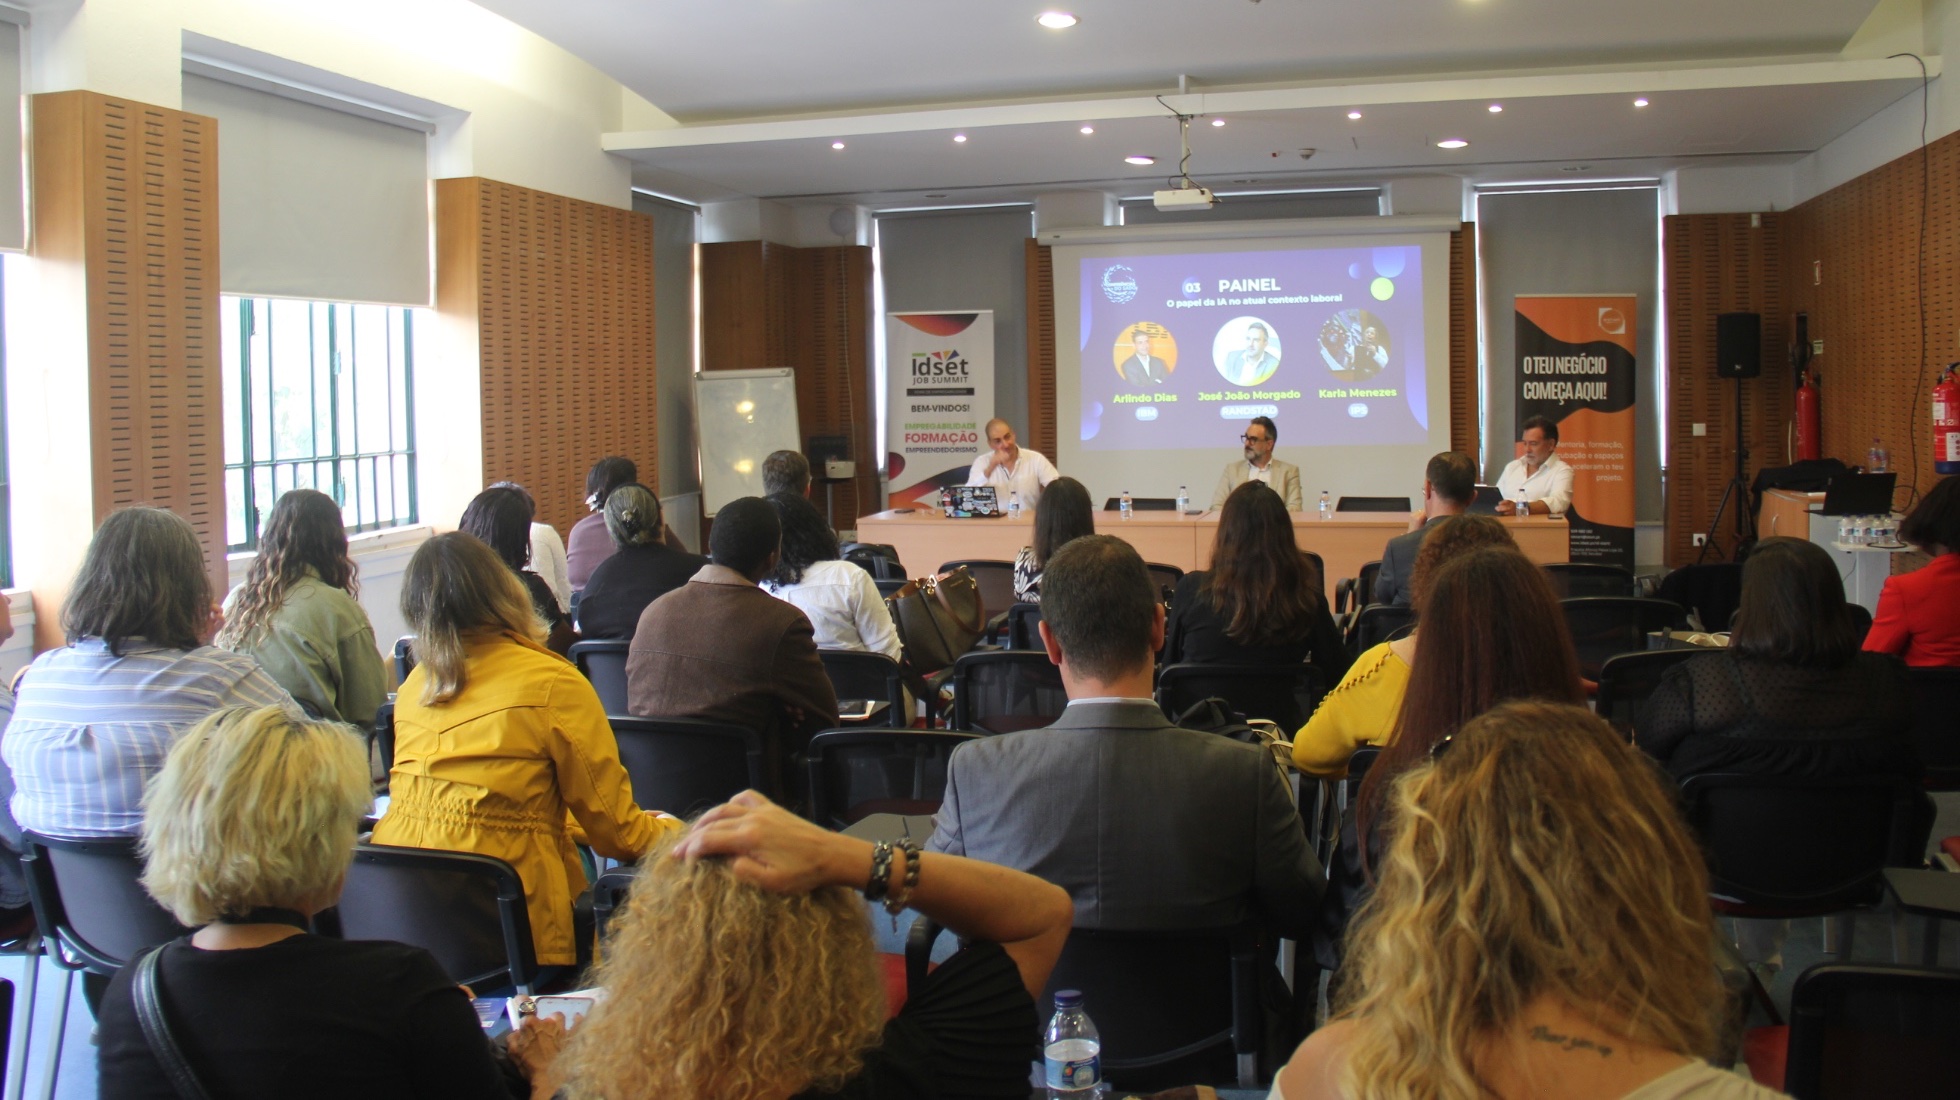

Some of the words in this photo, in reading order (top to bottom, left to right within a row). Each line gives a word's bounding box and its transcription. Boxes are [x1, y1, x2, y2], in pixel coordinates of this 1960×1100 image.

[1184, 282, 1201, 293] 03
[1218, 278, 1281, 293] PAINEL
[1166, 300, 1175, 308] O
[1176, 299, 1202, 309] papel
[1203, 298, 1216, 307] da
[1217, 298, 1228, 306] IA
[1242, 296, 1266, 305] atual
[1267, 295, 1310, 304] contexto
[1310, 293, 1343, 303] laboral
[912, 357, 969, 376] Idset
[1523, 356, 1533, 375] O
[1533, 356, 1555, 375] TEU
[1555, 352, 1607, 375] NEGÓCIO
[912, 376, 929, 386] JOB
[931, 376, 968, 384] SUMMIT
[1113, 394, 1153, 404] Arlindo
[1154, 393, 1178, 402] Dias
[1198, 391, 1223, 401] José
[1224, 391, 1250, 400] João
[1252, 390, 1301, 401] Morgado
[1318, 388, 1347, 398] Karla
[1348, 388, 1397, 398] Menezes
[1523, 381, 1574, 406] COMEÇA
[1574, 381, 1607, 402] AQUI!
[911, 404, 970, 413] BEM-VINDOS!
[1222, 405, 1277, 416] RANDSTAD
[904, 430, 978, 446] FORMAÇÃO
[905, 446, 978, 454] EMPREENDEDORISMO
